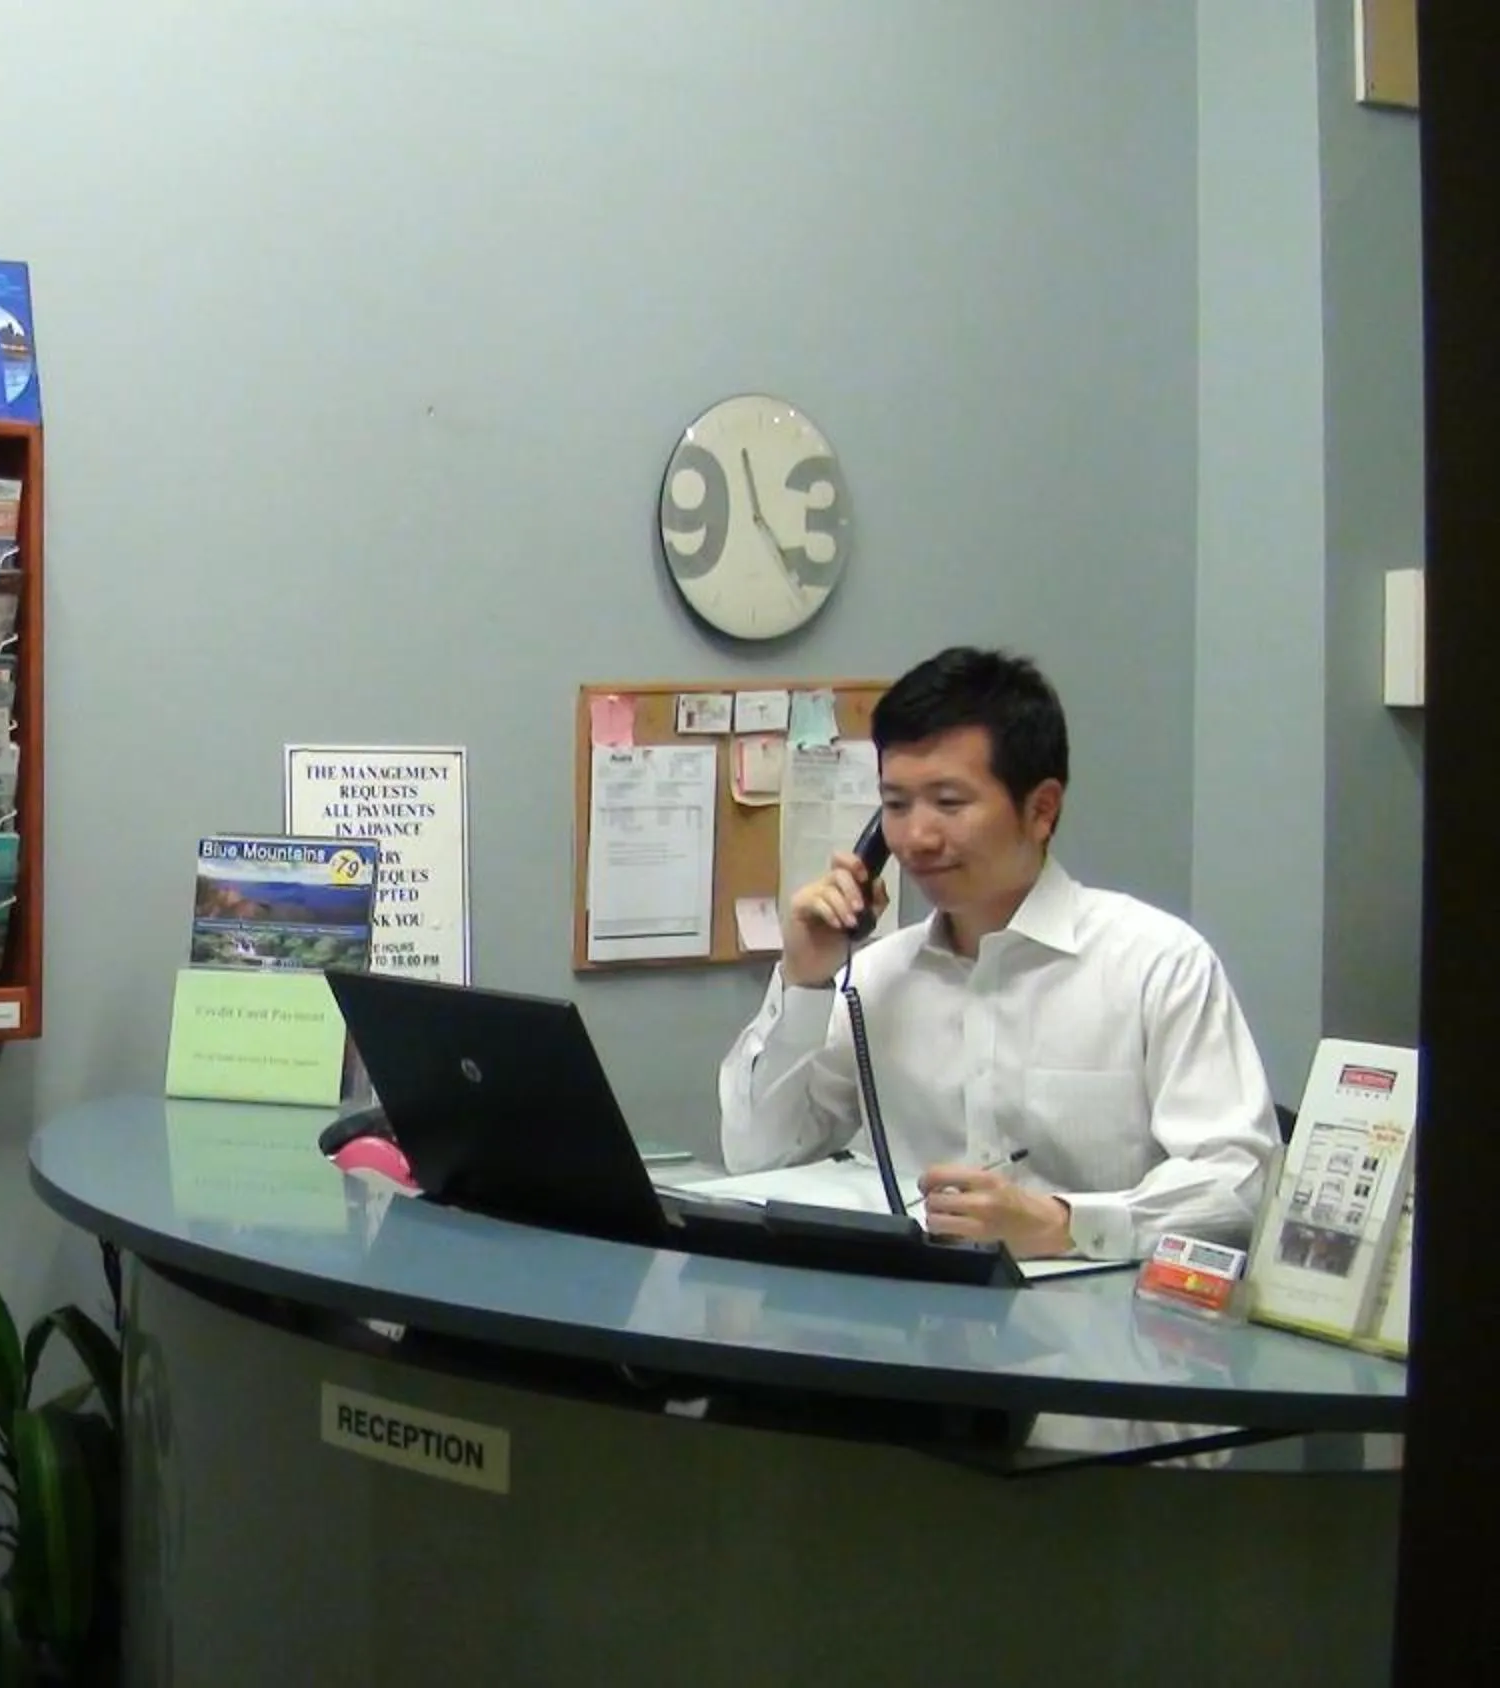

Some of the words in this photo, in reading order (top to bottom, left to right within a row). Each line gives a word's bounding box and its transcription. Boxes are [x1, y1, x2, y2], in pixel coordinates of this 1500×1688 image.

[661, 444, 730, 580] 9
[785, 455, 850, 588] 3
[306, 765, 338, 780] THE
[341, 766, 449, 781] MANAGEMENT
[339, 785, 419, 801] REQUESTS
[322, 803, 353, 818] ALL
[357, 804, 436, 818] PAYMENTS
[334, 823, 352, 837] IN
[358, 823, 423, 837] ADVANCE
[202, 840, 238, 860] Blue
[243, 842, 326, 863] Mountains
[378, 869, 430, 885] EQUES
[395, 913, 424, 928] YOU
[423, 955, 440, 968] PM
[195, 1005, 233, 1019] Credit
[237, 1007, 269, 1020] Card
[271, 1008, 326, 1022] Payment
[337, 1404, 485, 1470] RECEPTION
